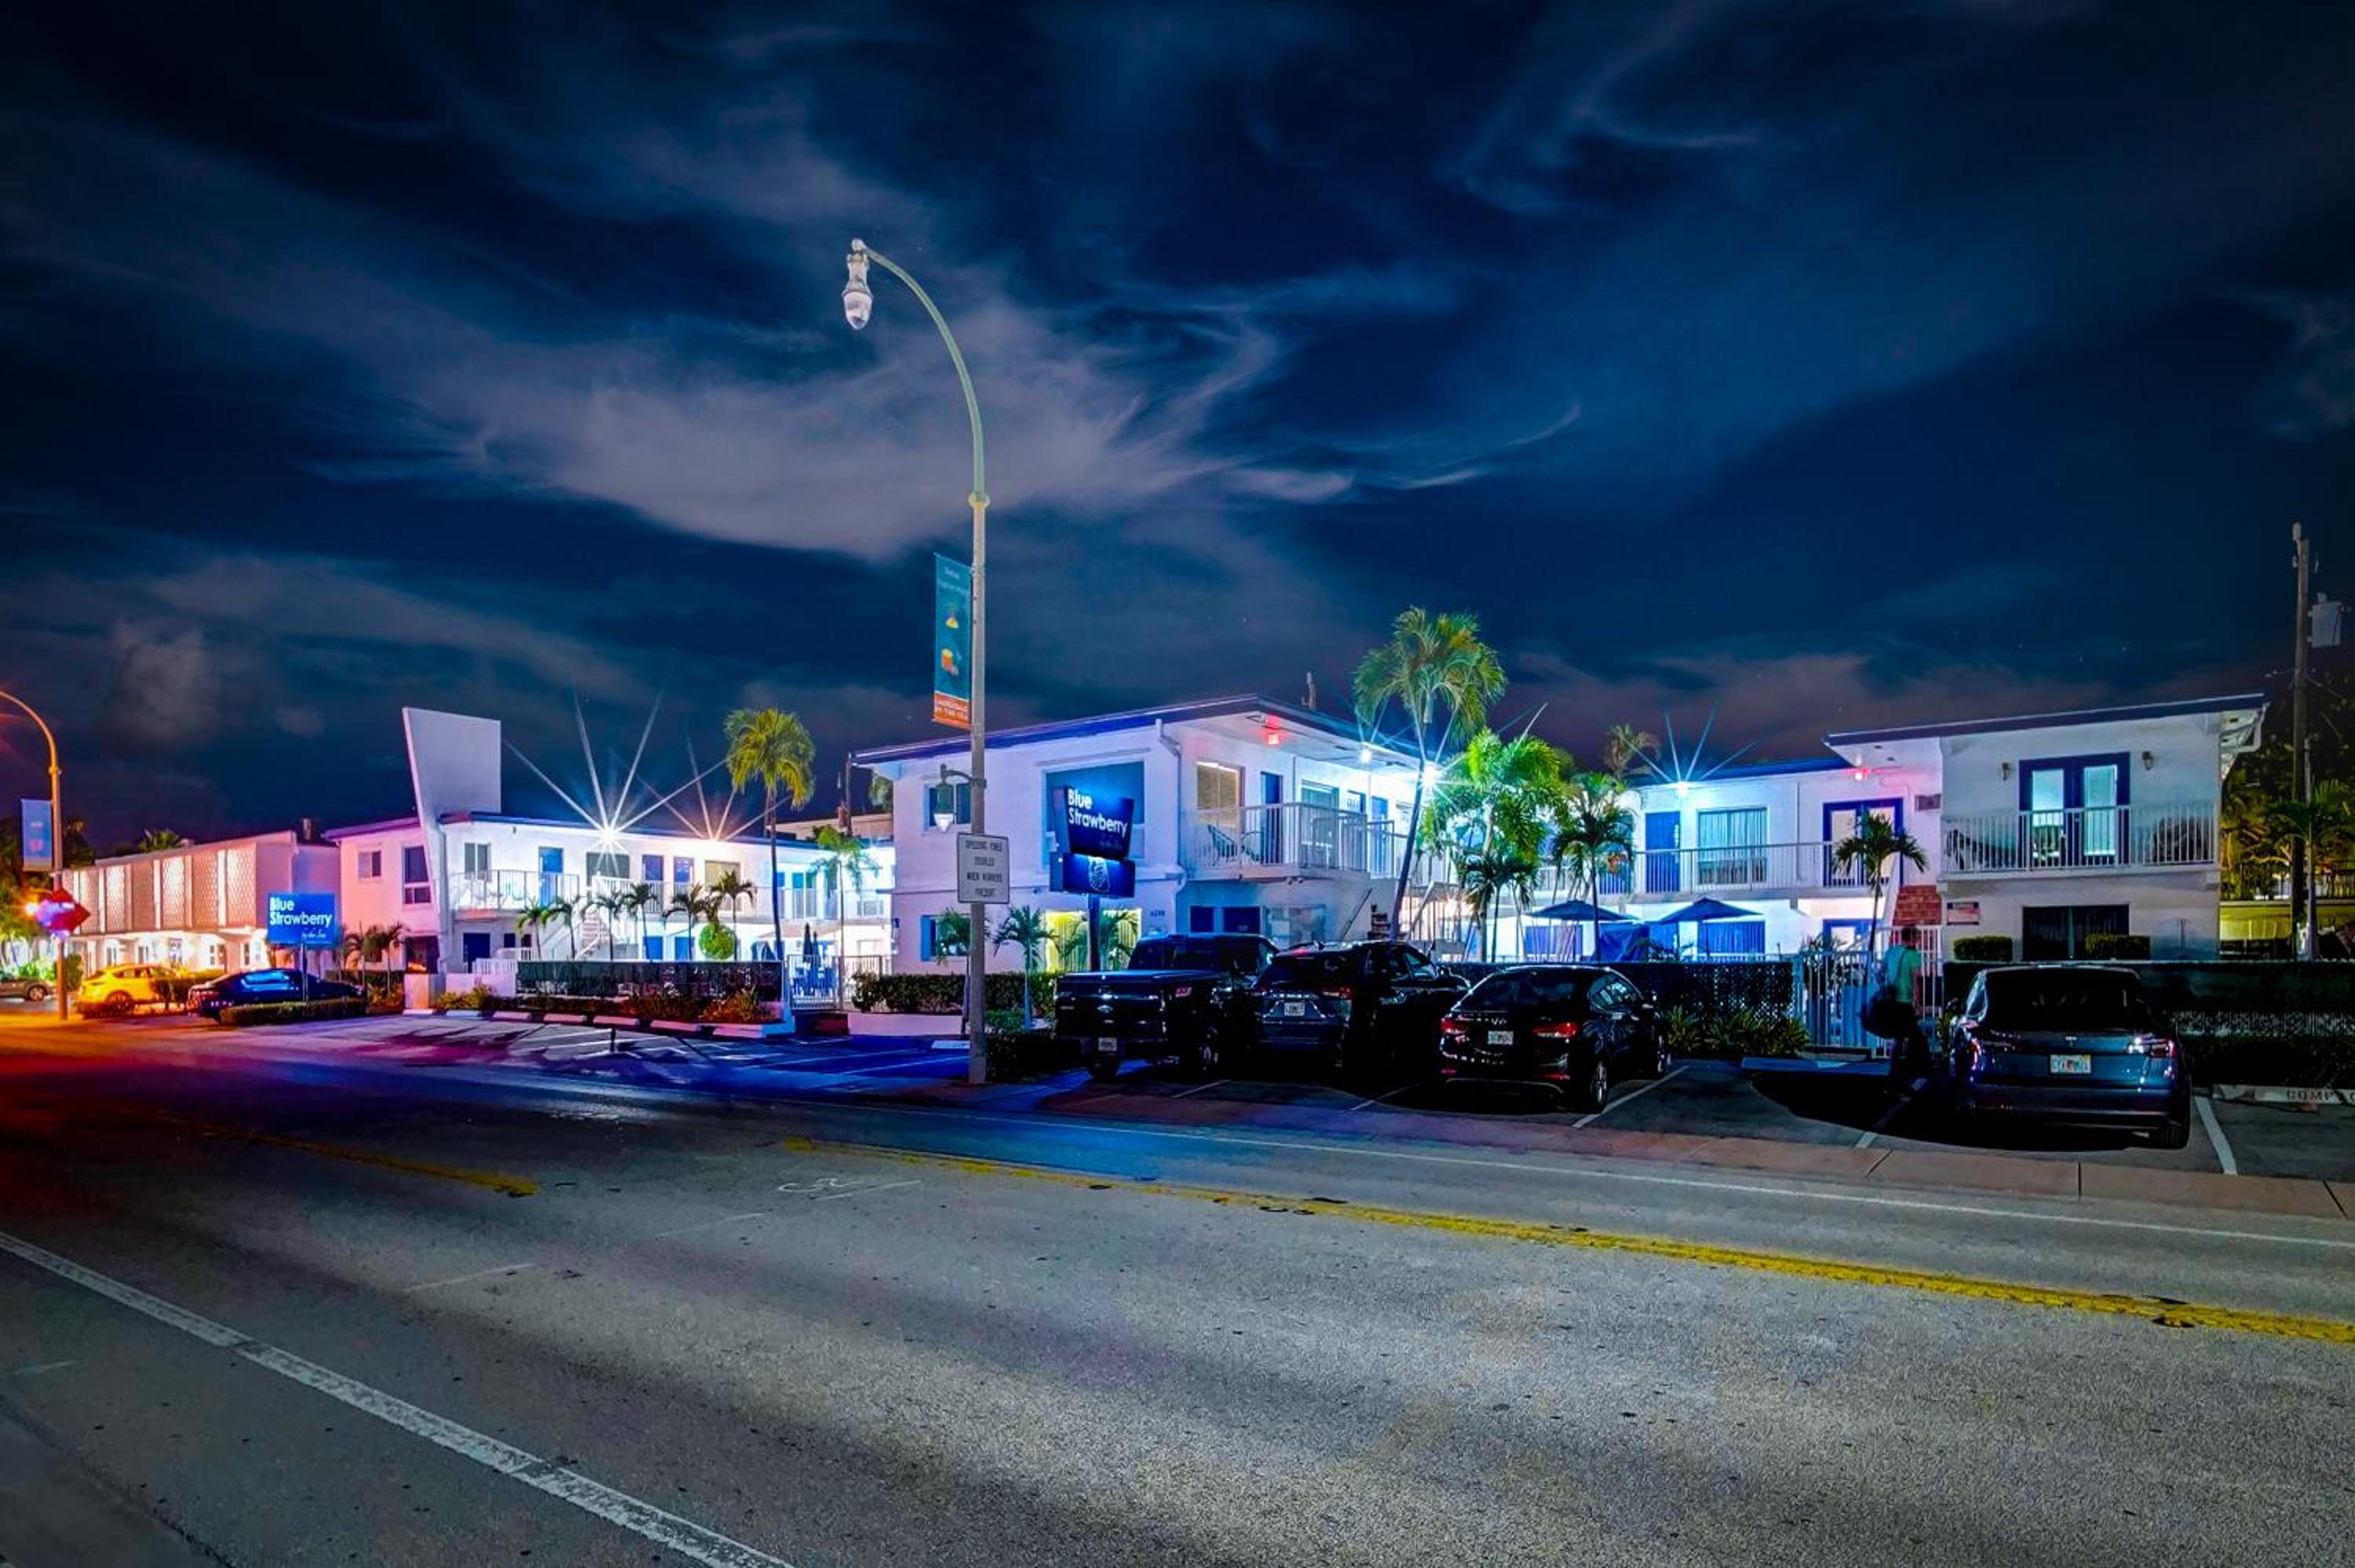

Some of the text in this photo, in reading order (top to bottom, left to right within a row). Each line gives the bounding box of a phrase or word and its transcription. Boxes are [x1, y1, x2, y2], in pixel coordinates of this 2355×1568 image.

[1068, 788, 1092, 810] Blue
[1068, 806, 1128, 838] Strawberry
[269, 897, 295, 910] Blue
[269, 911, 332, 928] Strawberry
